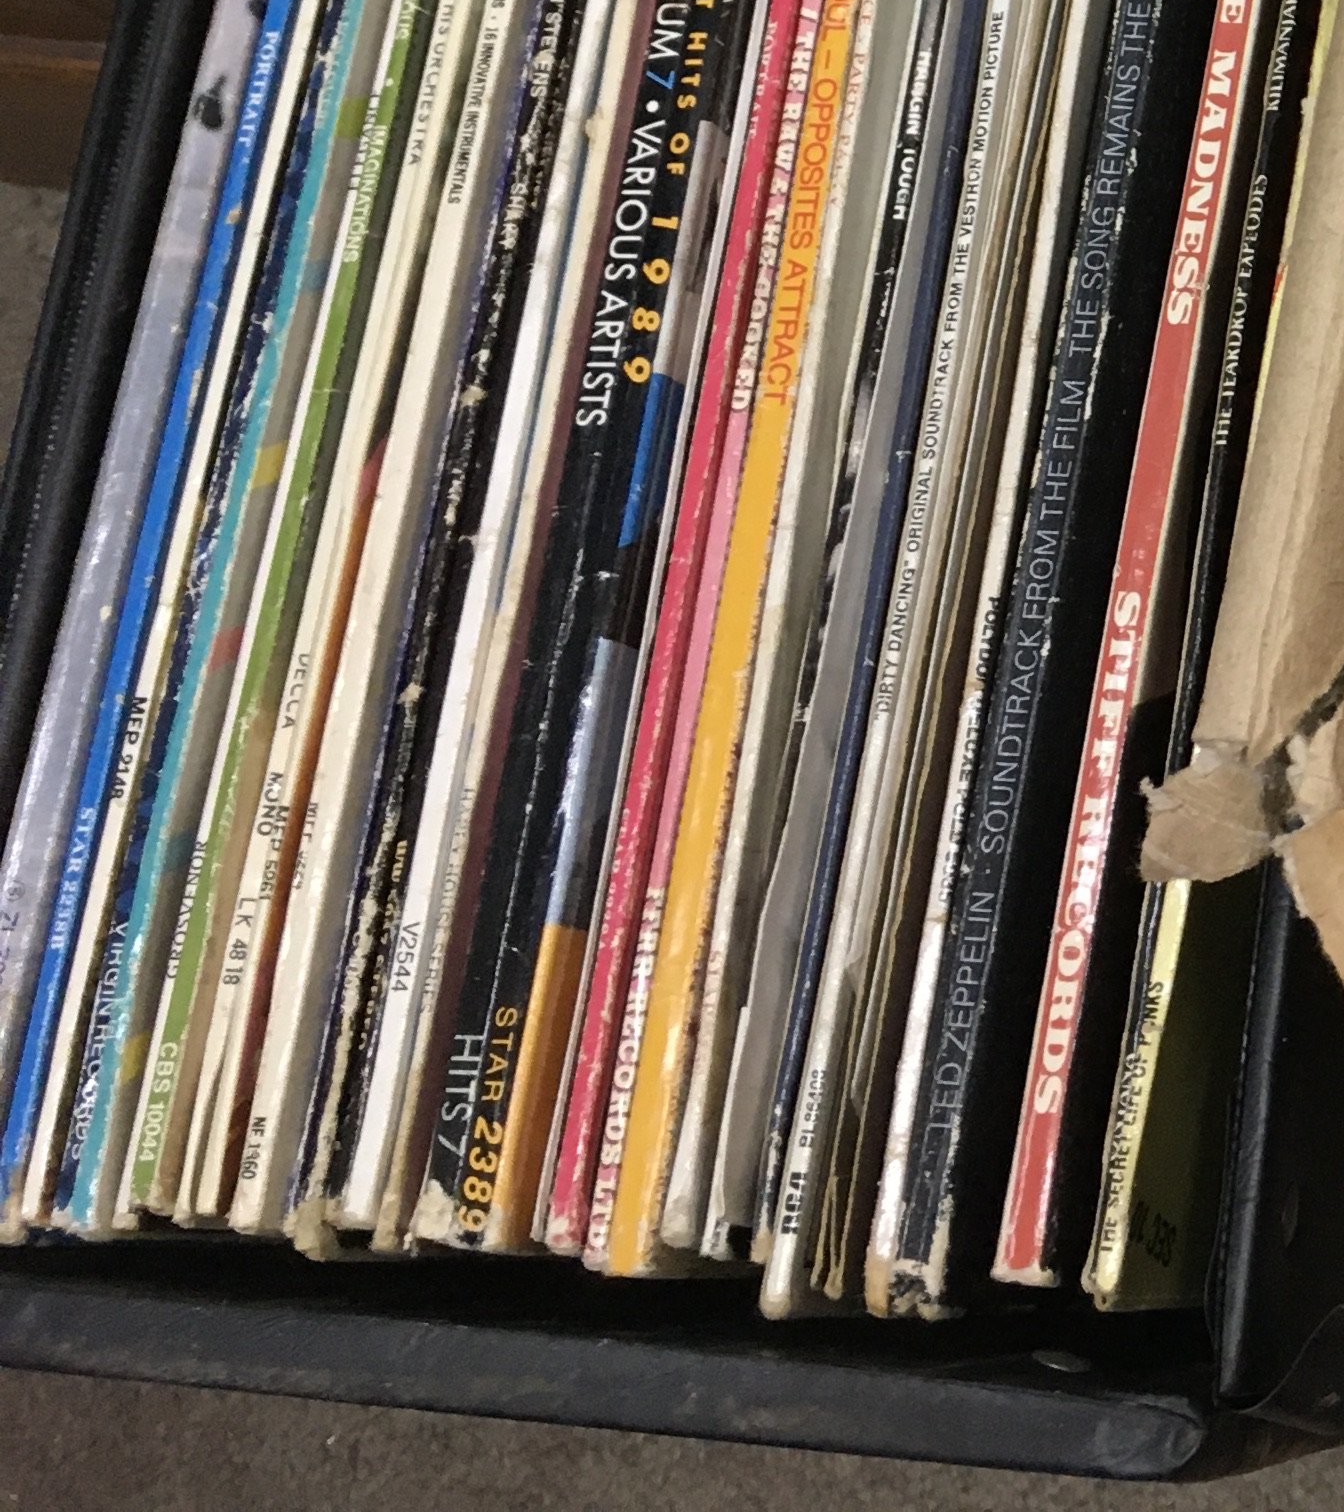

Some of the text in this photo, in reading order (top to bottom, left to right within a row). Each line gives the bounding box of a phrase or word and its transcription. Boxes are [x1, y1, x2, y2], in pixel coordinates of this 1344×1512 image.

[482, 26, 500, 41] 16
[674, 30, 709, 110] HITS
[786, 31, 816, 91] THE
[980, 10, 1007, 81] PICTURE
[1118, 1, 1152, 58] THE
[236, 30, 279, 147] PORTRAIT
[466, 42, 495, 109] INNOVATIVE
[641, 69, 675, 89] 7
[445, 110, 480, 204] INSTRUMENTALS
[662, 131, 691, 176] OF
[772, 101, 803, 169] RAW
[782, 77, 841, 249] OPPOSITES
[969, 87, 995, 153] MOTION
[1094, 63, 1142, 195] REMAINS
[340, 124, 388, 263] IMAGINATIONS
[603, 118, 664, 281] VARIOUS
[768, 178, 789, 196] &
[955, 157, 985, 238] VESTRON
[1163, 49, 1237, 325] MADNESS
[1236, 173, 1270, 280] EXPLODES
[755, 205, 784, 265] THE
[950, 243, 971, 276] THE
[1078, 205, 1116, 291] SONG
[758, 258, 811, 406] ATTRACT
[941, 282, 965, 333] FROM
[1067, 298, 1100, 358] THE
[574, 290, 632, 427] ARTISTS
[918, 337, 957, 460] SOUNDTRACK
[903, 465, 935, 553] ORIGINAL
[977, 379, 1086, 856] SOUNDTRACK FROM THE FILM
[1026, 590, 1143, 1115] STIFF RECORDS
[387, 920, 421, 994] V2544
[942, 890, 996, 1053] ZEPPELIN
[136, 1041, 178, 1163] CBS 10044
[430, 1033, 486, 1157] HITS 7
[453, 1005, 519, 1234] STAR 2389
[596, 989, 651, 1165] RECORDS
